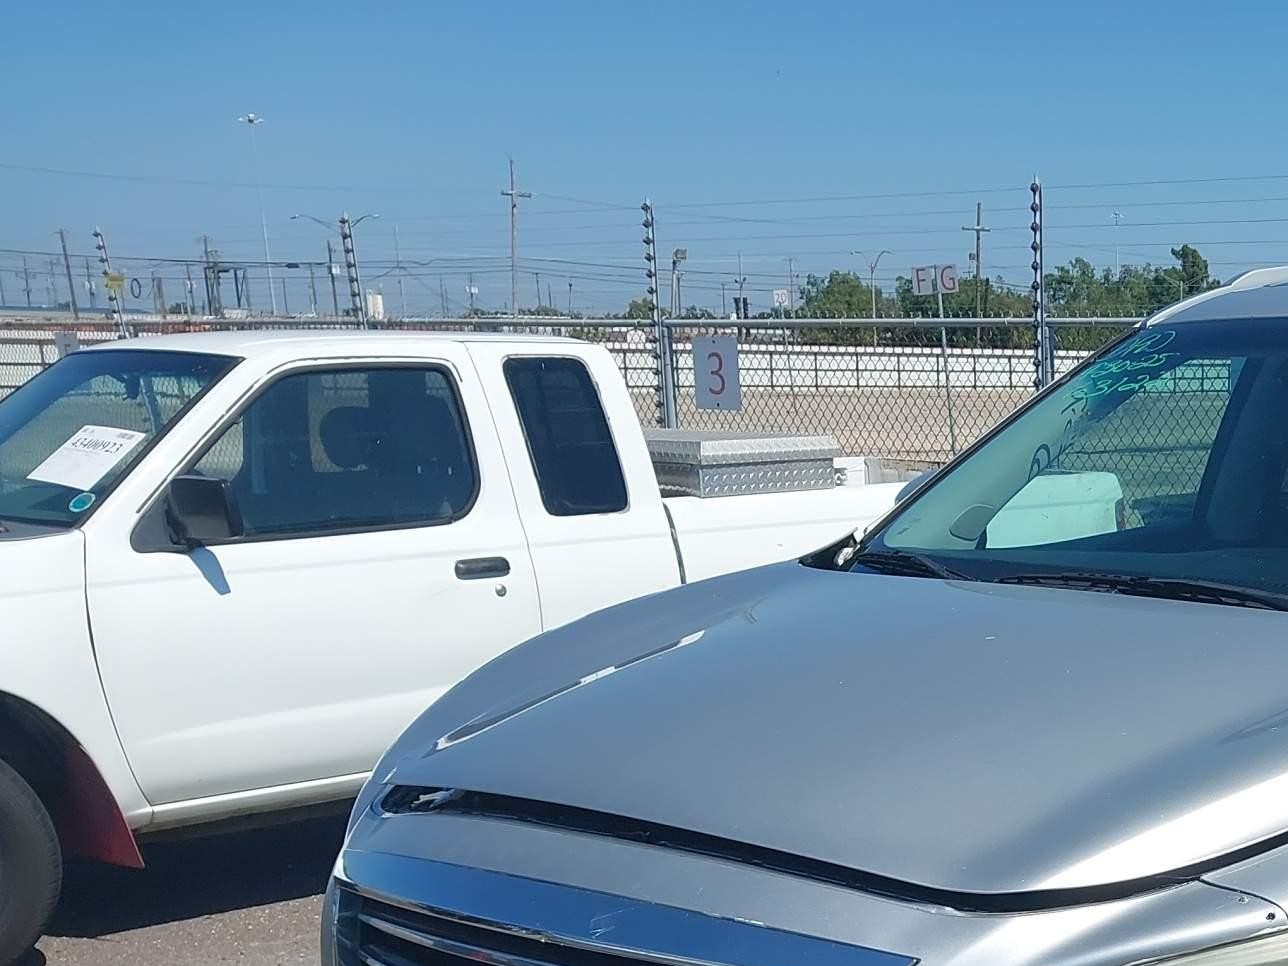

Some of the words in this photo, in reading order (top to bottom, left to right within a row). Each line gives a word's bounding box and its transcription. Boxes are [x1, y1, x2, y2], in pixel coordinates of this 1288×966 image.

[915, 268, 928, 293] F
[940, 267, 956, 290] G
[707, 352, 725, 395] 3
